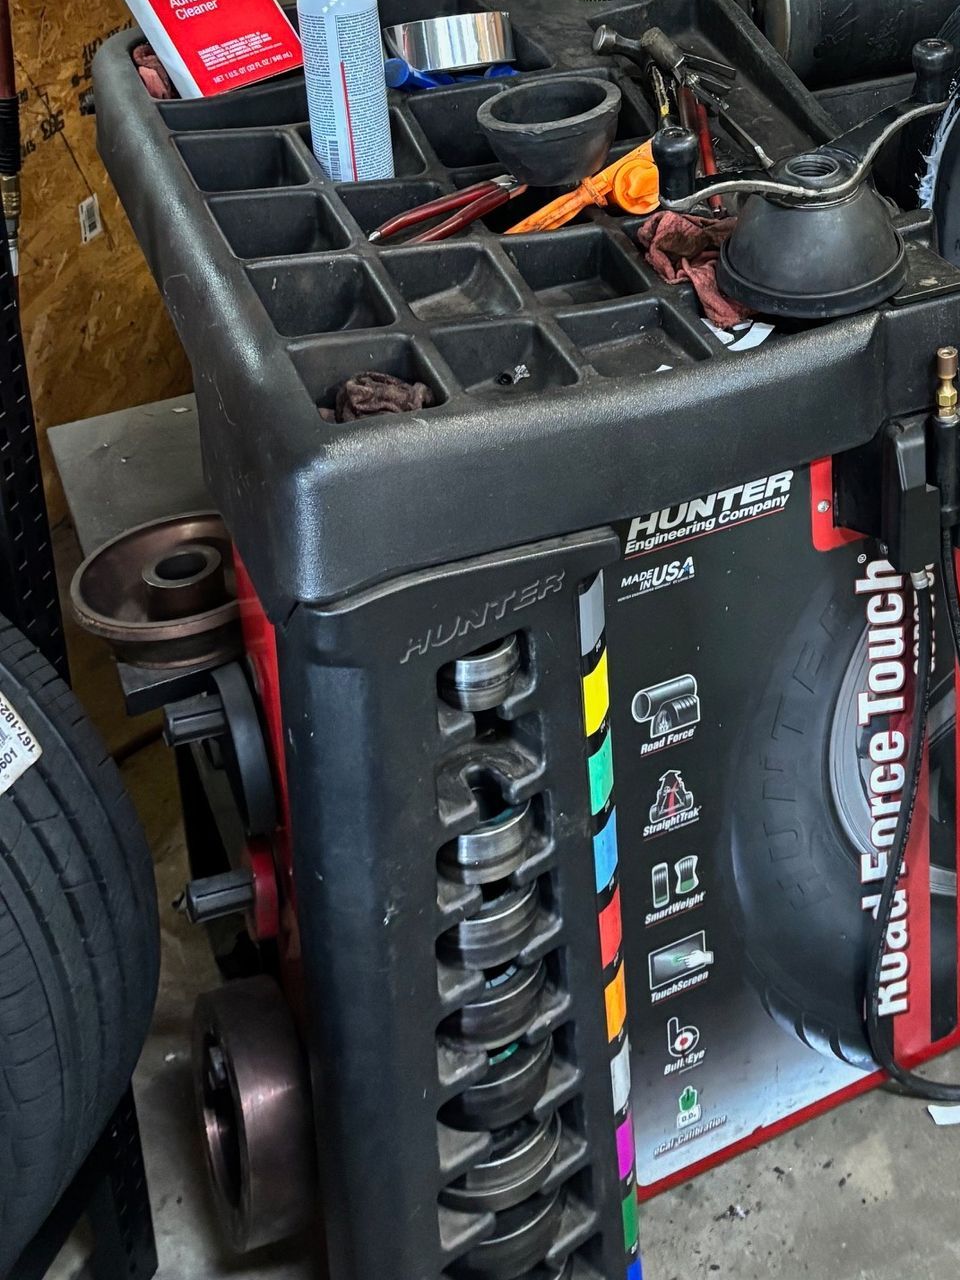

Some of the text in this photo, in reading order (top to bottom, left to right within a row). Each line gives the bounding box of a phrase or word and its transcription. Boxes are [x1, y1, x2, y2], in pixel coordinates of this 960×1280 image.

[175, 0, 218, 20] Cleaner
[627, 470, 794, 541] HUNTER
[624, 494, 790, 555] Engineering Company
[620, 568, 654, 588] MADE
[639, 579, 652, 591] IN
[651, 555, 695, 586] USA
[400, 569, 566, 664] HUNTER
[0, 696, 36, 753] 167-182-
[640, 728, 695, 755] Road Force
[643, 807, 700, 837] StraightTrak
[645, 891, 705, 925] SmartWeight
[651, 970, 709, 1003] TouchScreen
